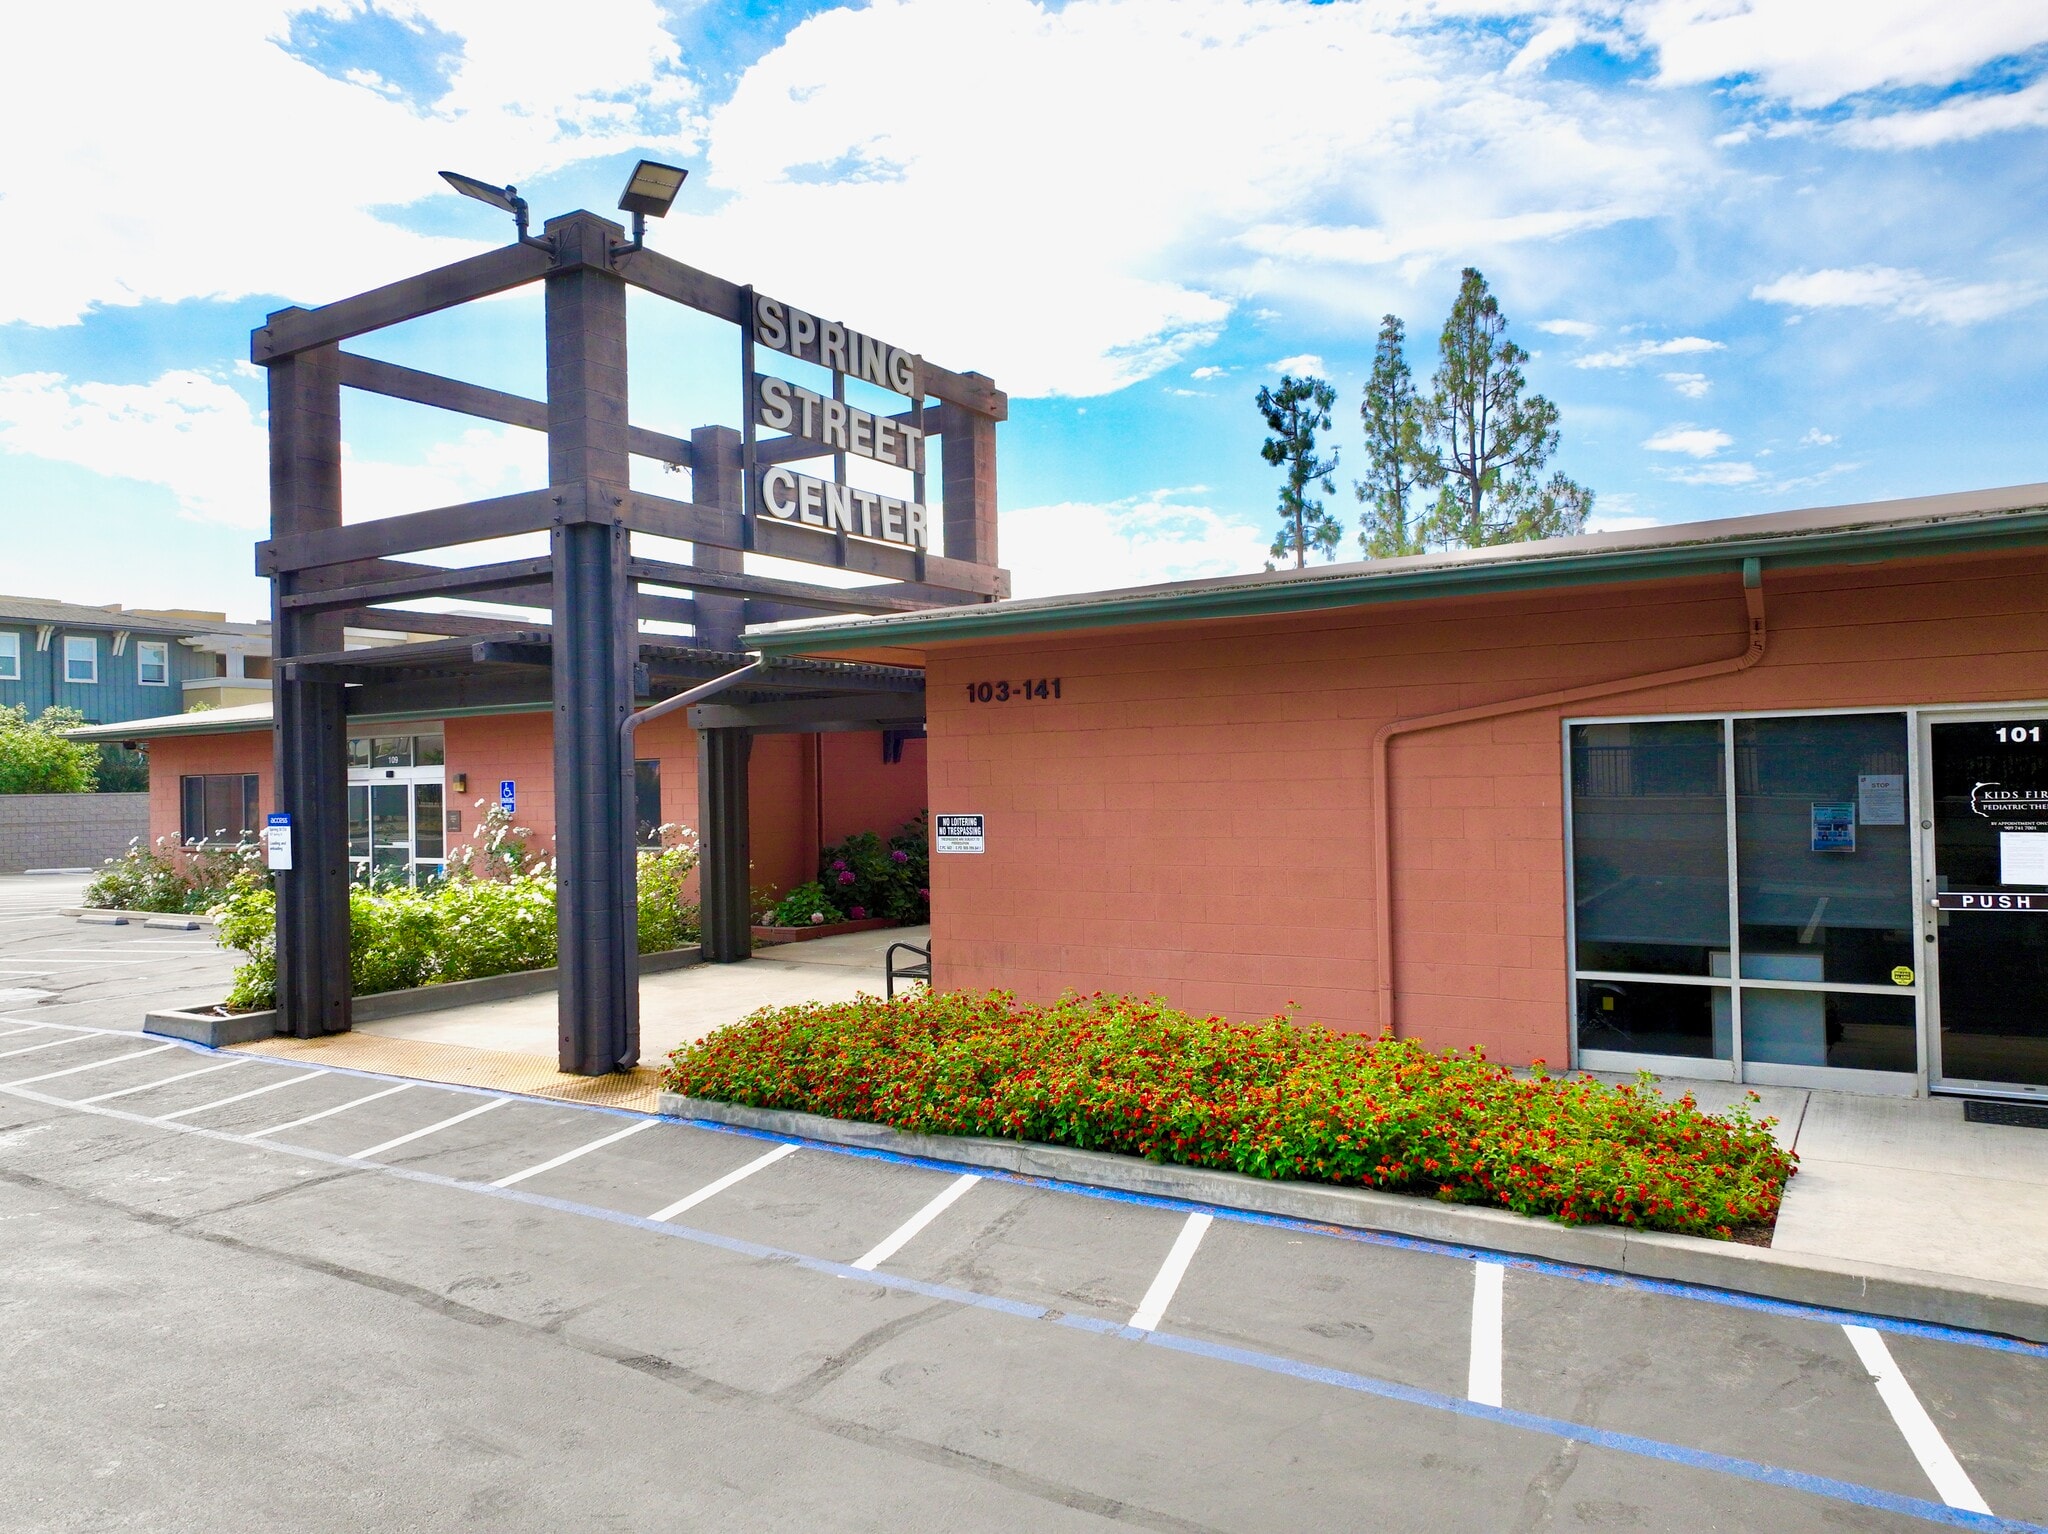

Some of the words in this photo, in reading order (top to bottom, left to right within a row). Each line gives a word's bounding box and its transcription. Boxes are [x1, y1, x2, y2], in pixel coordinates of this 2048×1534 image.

[757, 296, 915, 397] SPRING
[760, 376, 922, 470] STREET
[762, 466, 928, 548] CENTER
[967, 678, 1061, 703] 103-141
[1996, 726, 2040, 743] 101
[388, 756, 399, 764] 109
[1984, 791, 2019, 799] KIDS
[942, 817, 951, 826] NO
[951, 817, 978, 826] LOITERING
[938, 826, 947, 836] NO
[947, 826, 982, 836] TRESPASSING
[1962, 895, 2031, 909] PUSH
